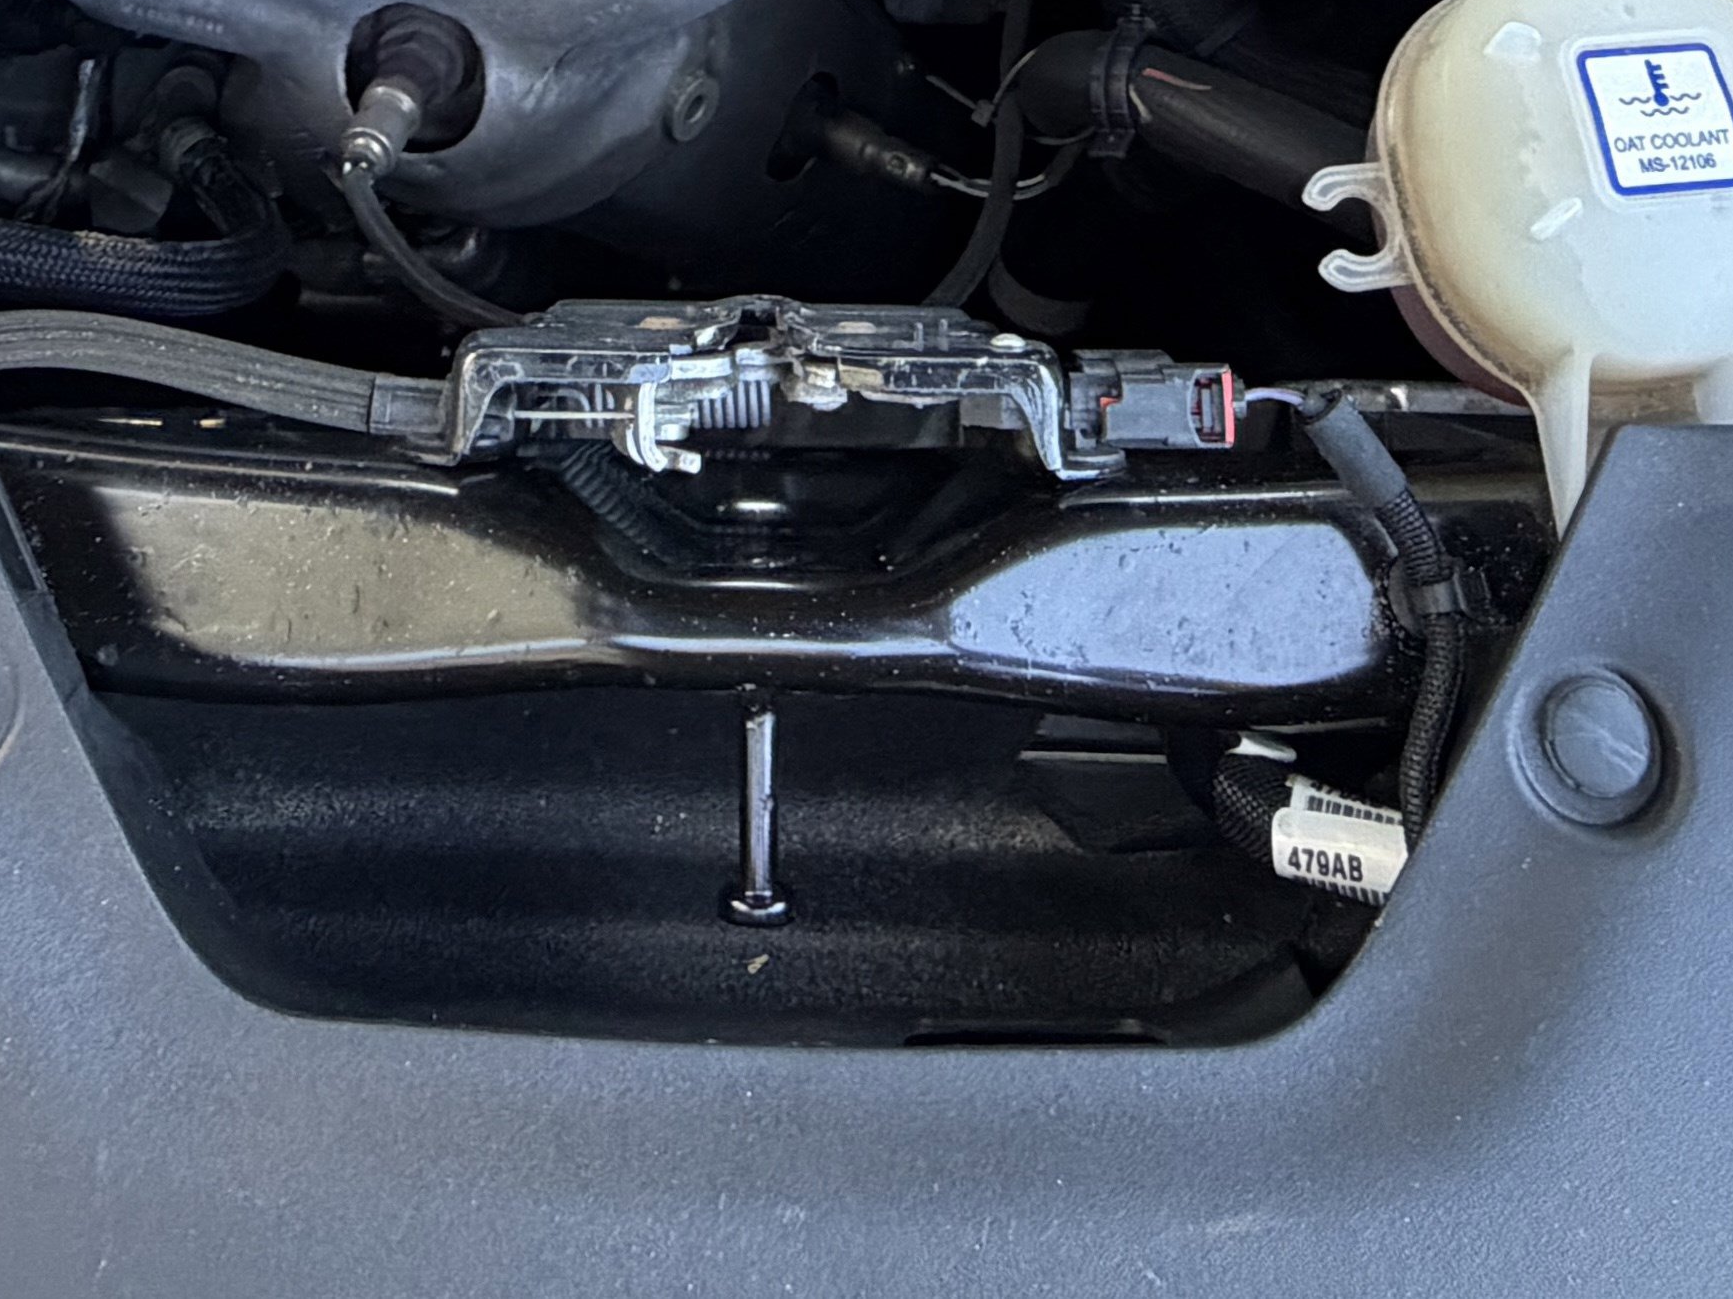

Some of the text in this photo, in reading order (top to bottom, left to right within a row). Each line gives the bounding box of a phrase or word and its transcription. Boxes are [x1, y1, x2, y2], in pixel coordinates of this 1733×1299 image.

[1614, 129, 1729, 153] OAT COOLANT
[1638, 152, 1717, 173] MS-12106
[1287, 846, 1364, 883] 479AB
